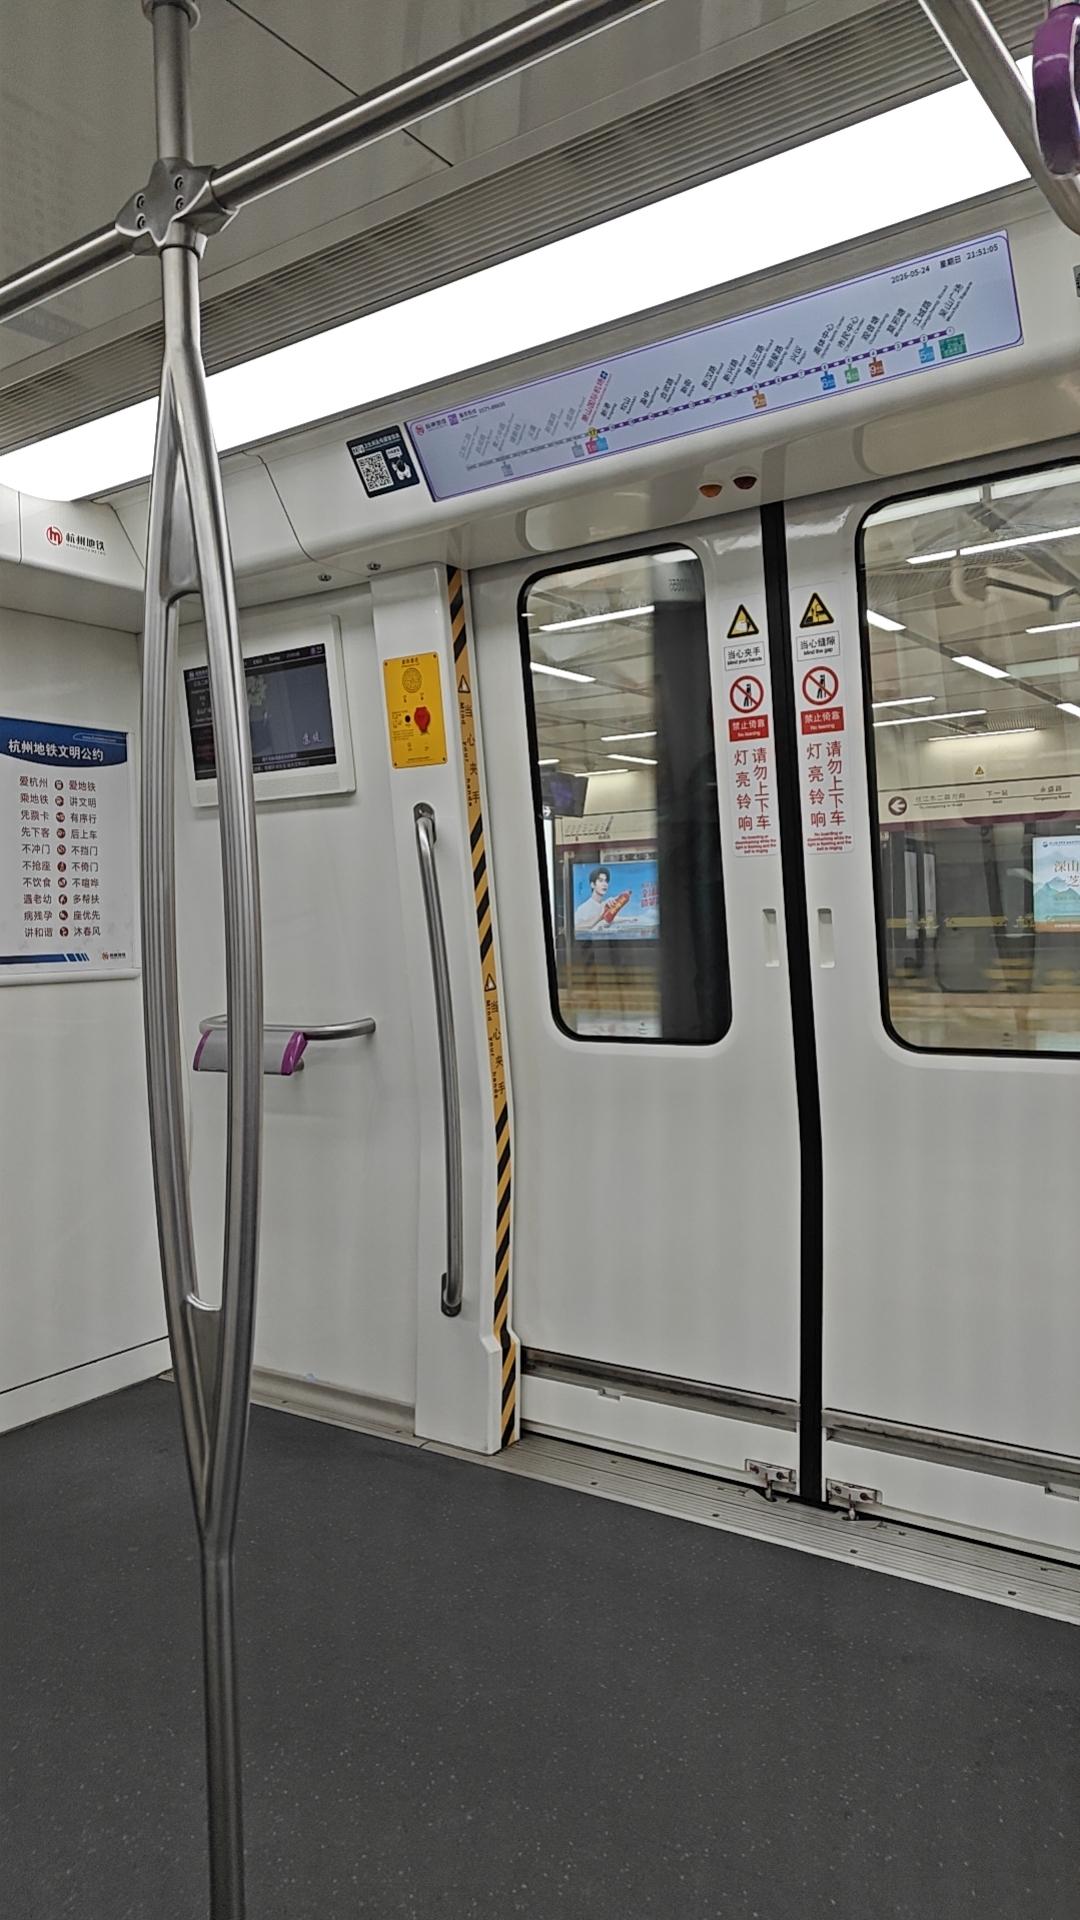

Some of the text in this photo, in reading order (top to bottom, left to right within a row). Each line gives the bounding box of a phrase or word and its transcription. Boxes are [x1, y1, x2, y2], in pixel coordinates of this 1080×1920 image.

[891, 244, 999, 284] 2026-05-24 星期日 21:51:05
[938, 284, 964, 318] 吴山广场
[912, 300, 932, 326] 江城路
[838, 316, 860, 348] 市民中心
[861, 316, 880, 341] 观音塘
[744, 344, 765, 376] 建设三路
[767, 345, 784, 369] 明星路
[701, 365, 718, 388] 新汉路
[722, 358, 739, 382] 新兴路
[66, 532, 104, 551] 杭州地铁
[800, 636, 836, 650] 当心缝隙
[728, 646, 760, 660] 当心夹手
[732, 718, 766, 730] 禁止倚靠
[804, 710, 841, 724] 禁止倚靠
[8, 739, 104, 762] 杭州地铁文明公约
[19, 776, 96, 792] 爱杭州 爱地铁
[734, 749, 752, 832] 灯亮铃响
[752, 746, 771, 830] 请勿上下车
[806, 742, 826, 828] 灯亮铃响
[826, 740, 846, 826] 请勿上下车
[20, 792, 97, 808] 乘地铁 讲文明
[21, 810, 97, 824] 凭票卡 有序行
[21, 826, 98, 840] 先下客 后上车
[22, 843, 98, 856] 不冲门 不挡门
[22, 860, 99, 872] 不抢座 不倚门
[22, 876, 100, 888] 不饮食 不喧哗
[23, 894, 100, 904] 遇老幼 多帮扶
[24, 910, 101, 922] 病残孕 座优先
[24, 926, 101, 938] 讲和谐 沐春风
